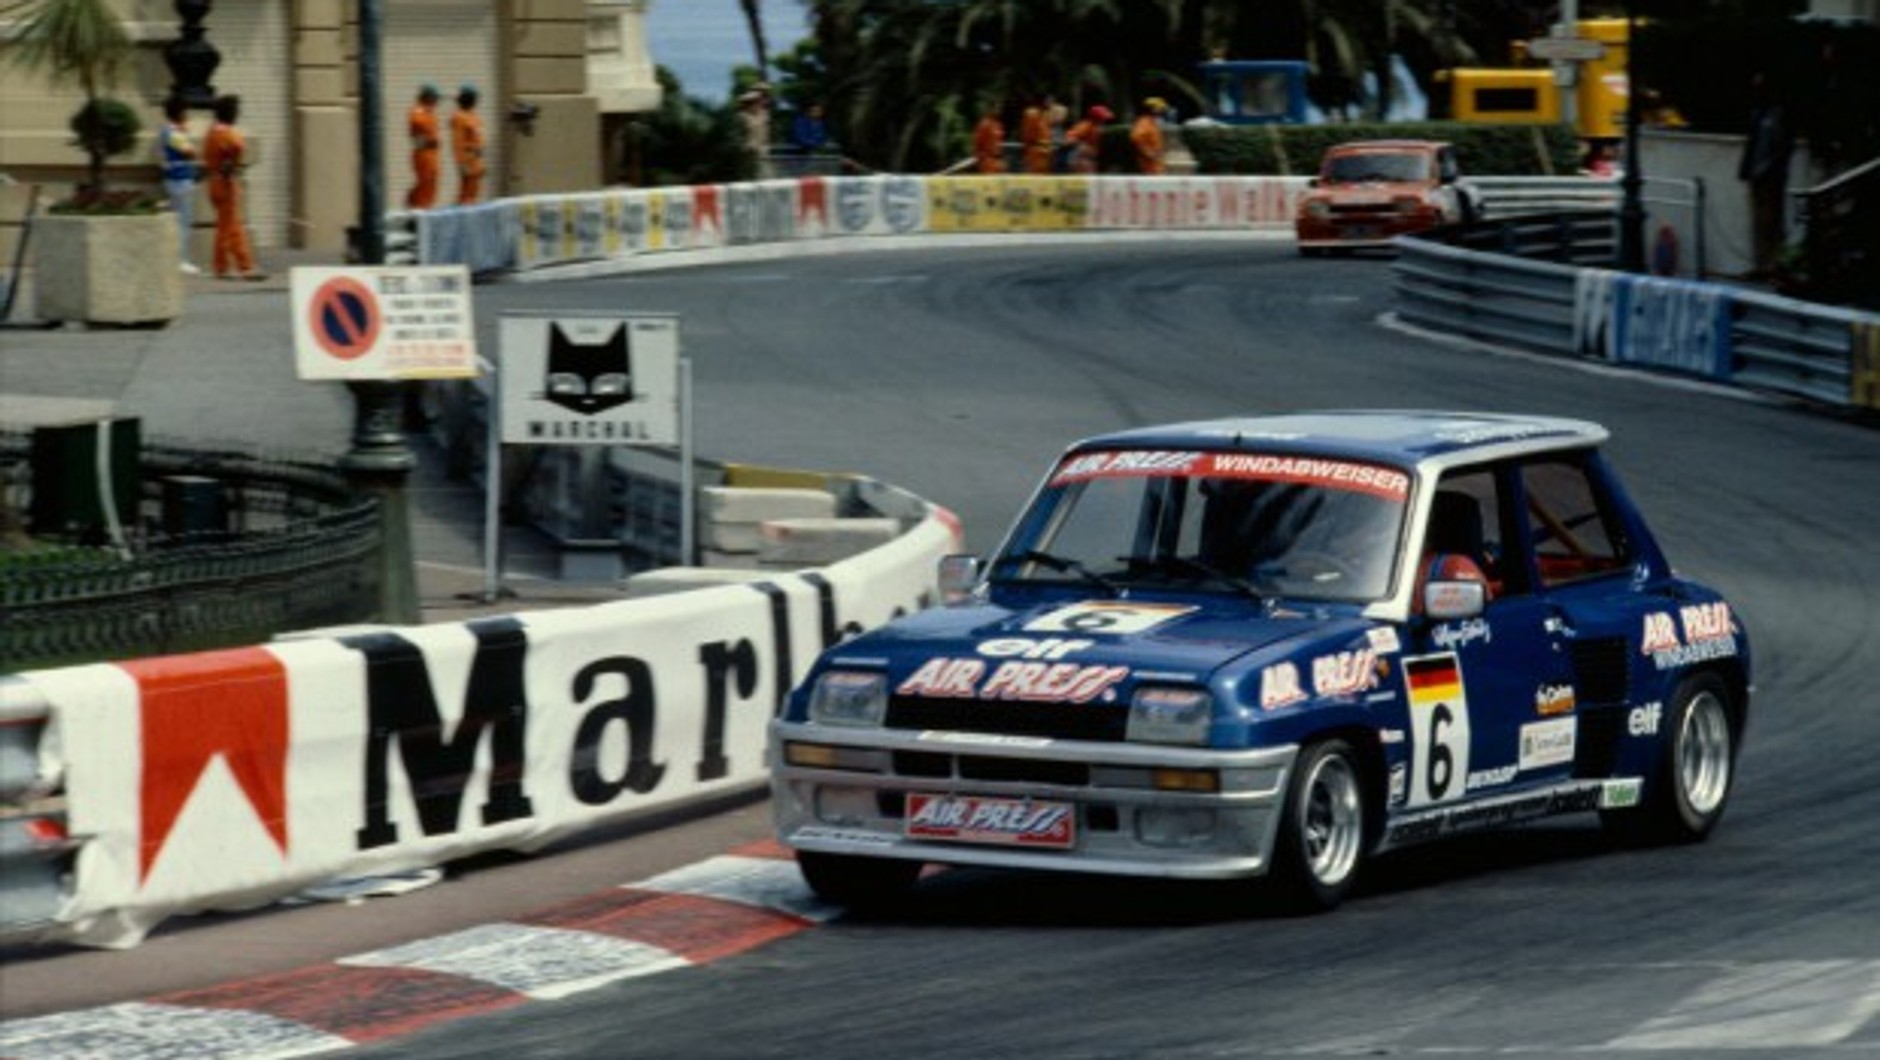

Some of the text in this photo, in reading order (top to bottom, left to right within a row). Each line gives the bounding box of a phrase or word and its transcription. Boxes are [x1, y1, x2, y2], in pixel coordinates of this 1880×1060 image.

[527, 420, 651, 441] MARCHAL
[1213, 455, 1409, 493] WINDABWEISER
[897, 658, 1129, 704] AIR PRESS
[336, 572, 900, 850] Marl
[1628, 701, 1663, 736] elf
[1427, 702, 1453, 801] 6
[911, 800, 1070, 834] AIR PRESS
